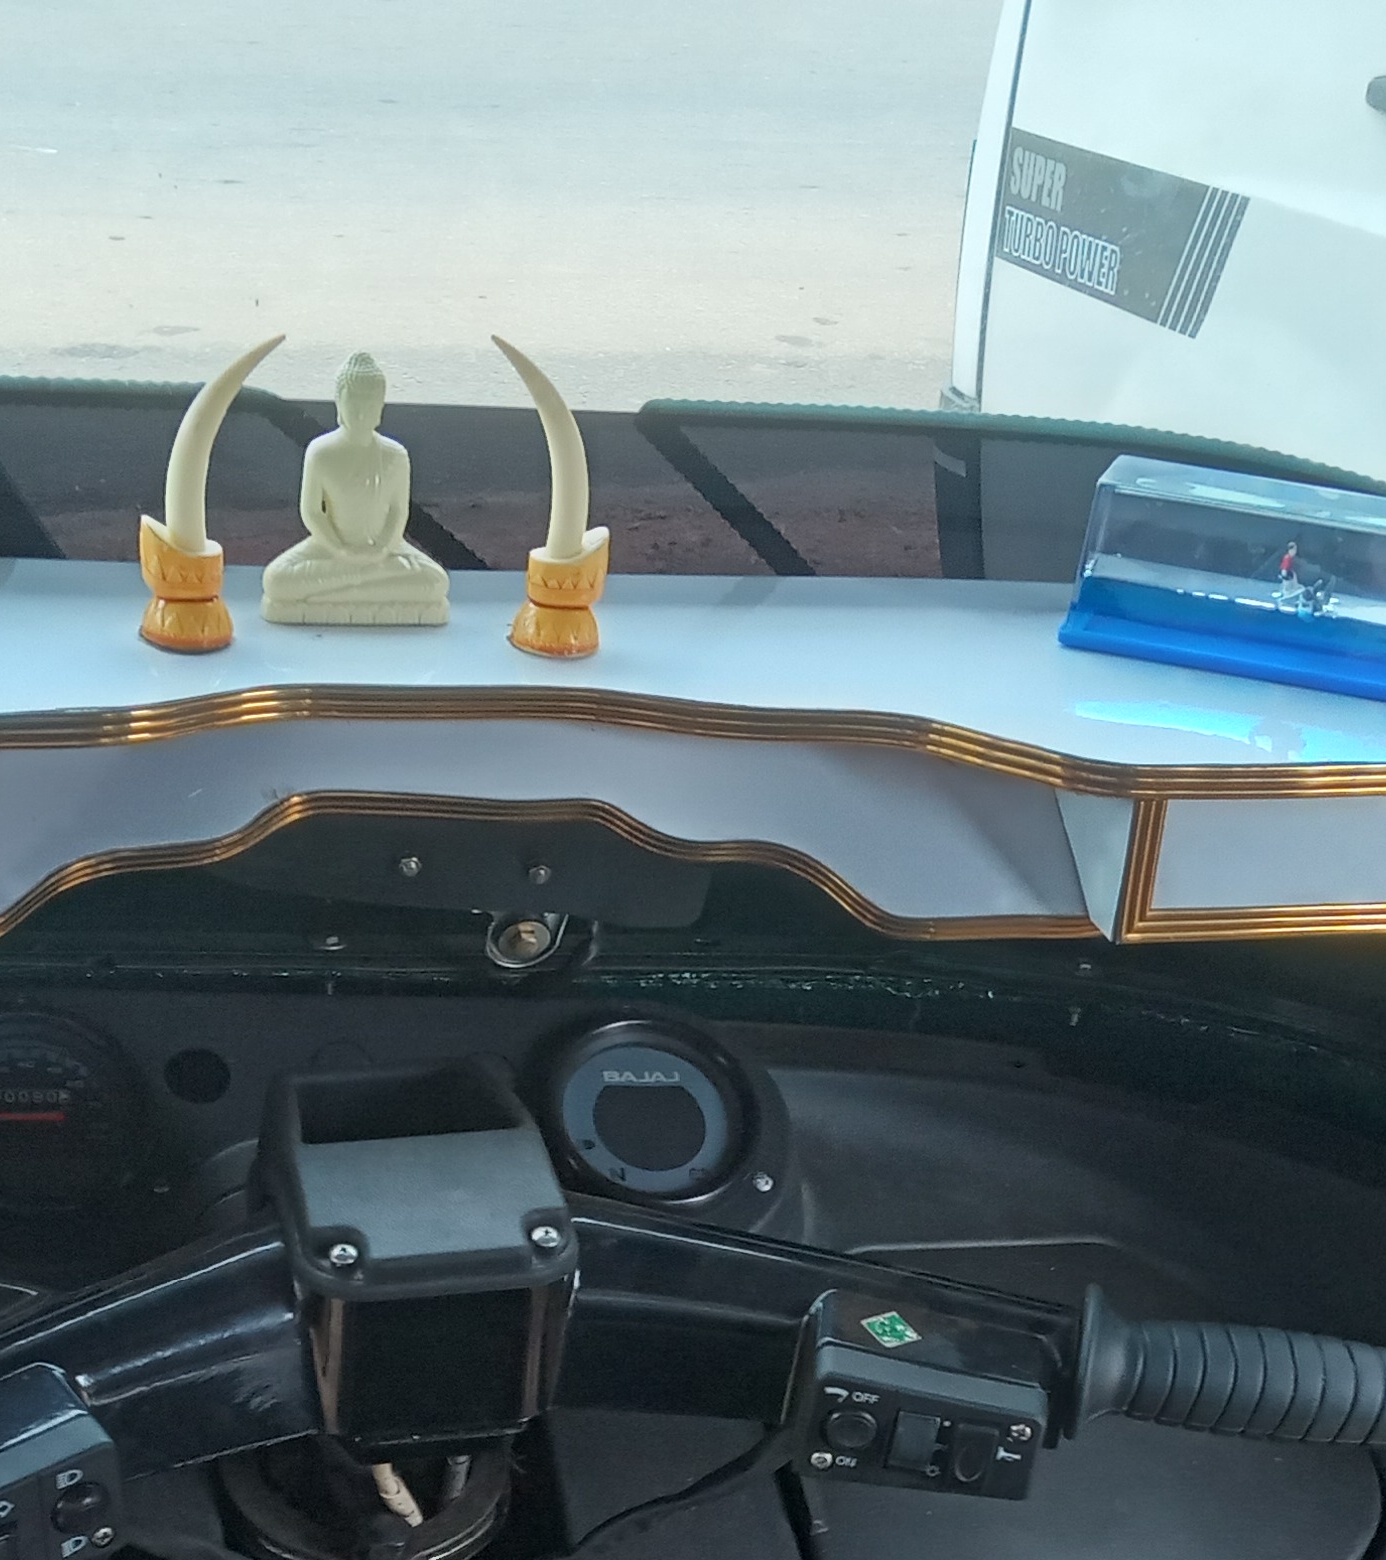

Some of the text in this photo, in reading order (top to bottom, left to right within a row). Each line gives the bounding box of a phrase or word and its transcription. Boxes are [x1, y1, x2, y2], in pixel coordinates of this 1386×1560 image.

[1010, 146, 1067, 214] SUPER
[1003, 205, 1121, 296] TURBO POWER
[602, 1069, 681, 1083] BAJAJ
[850, 1390, 882, 1405] OFF
[834, 1454, 859, 1469] ON
